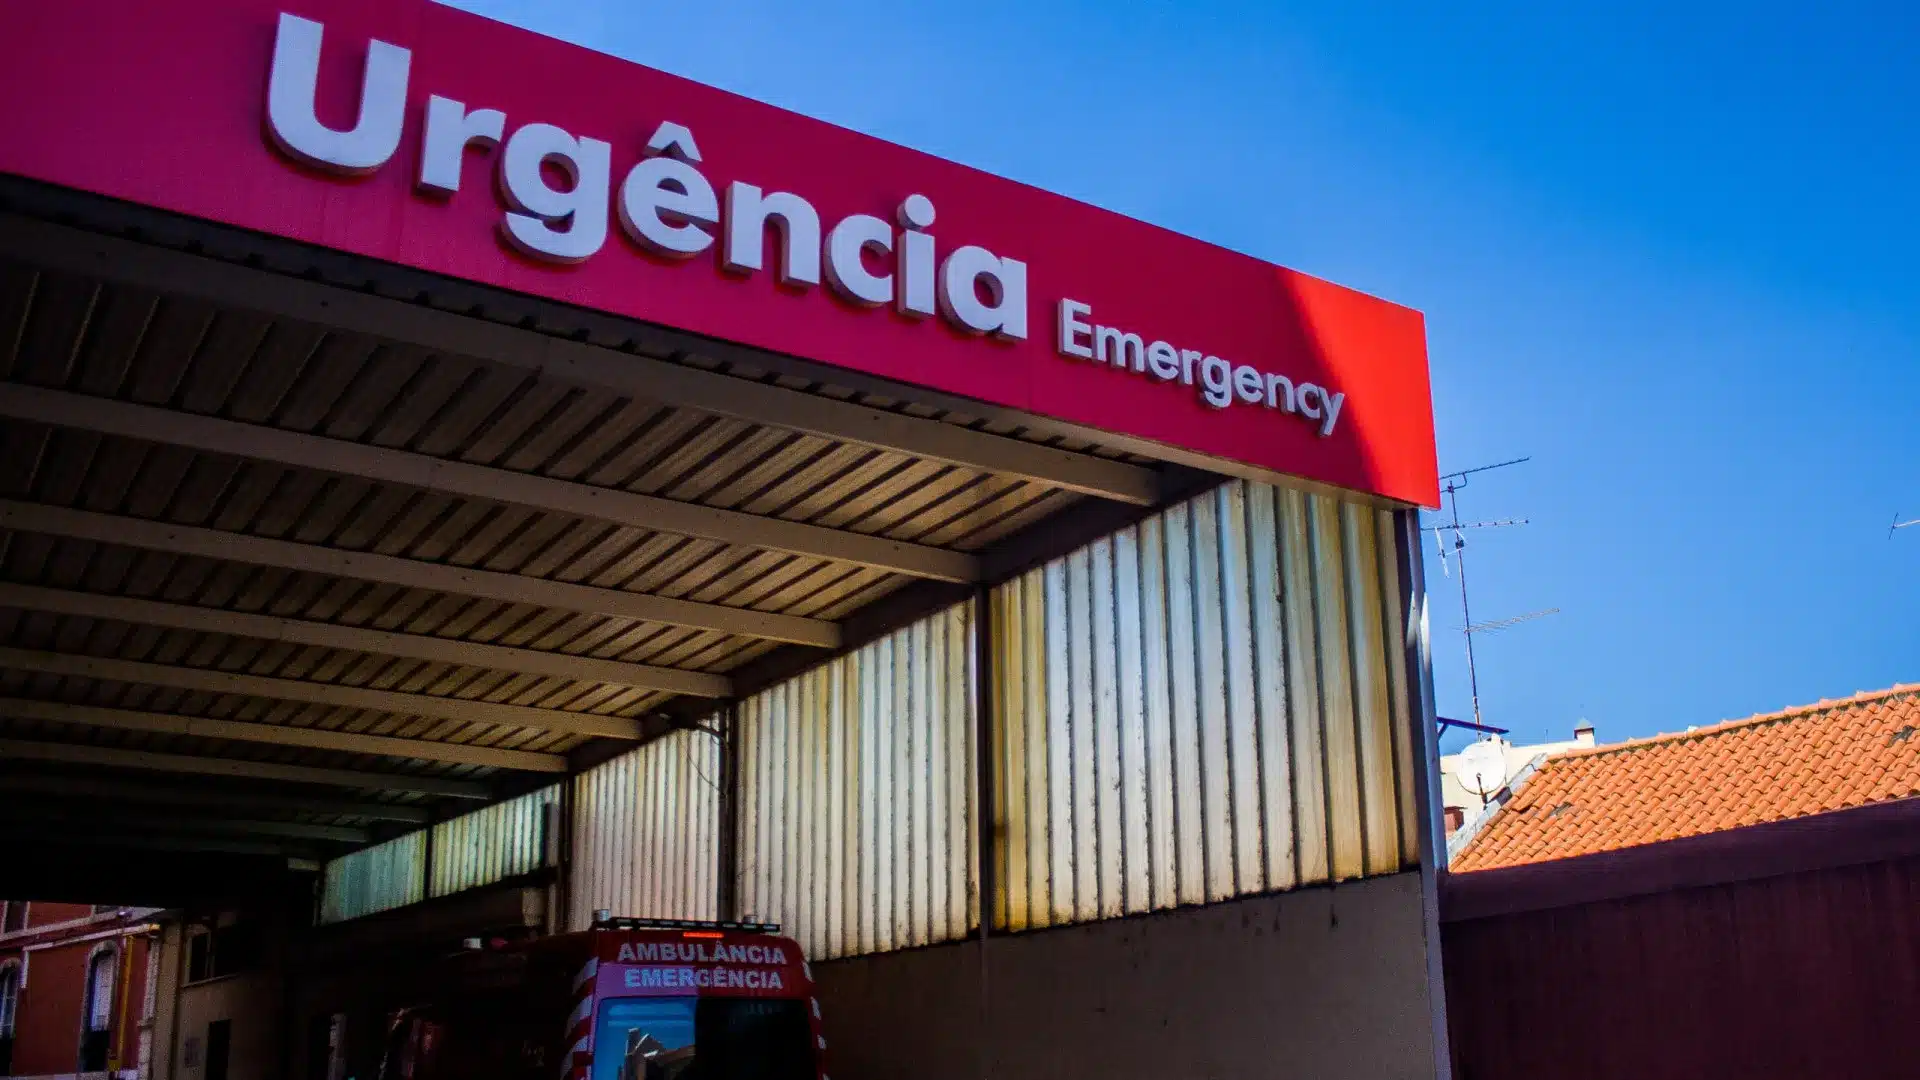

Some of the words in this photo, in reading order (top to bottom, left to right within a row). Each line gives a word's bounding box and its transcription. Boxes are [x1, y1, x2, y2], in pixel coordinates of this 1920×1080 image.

[267, 12, 1028, 341] Urgência
[1058, 298, 1345, 436] Emergency
[617, 941, 786, 964] AMBULÂNCIA
[624, 967, 783, 989] EMERGÊNCIA
